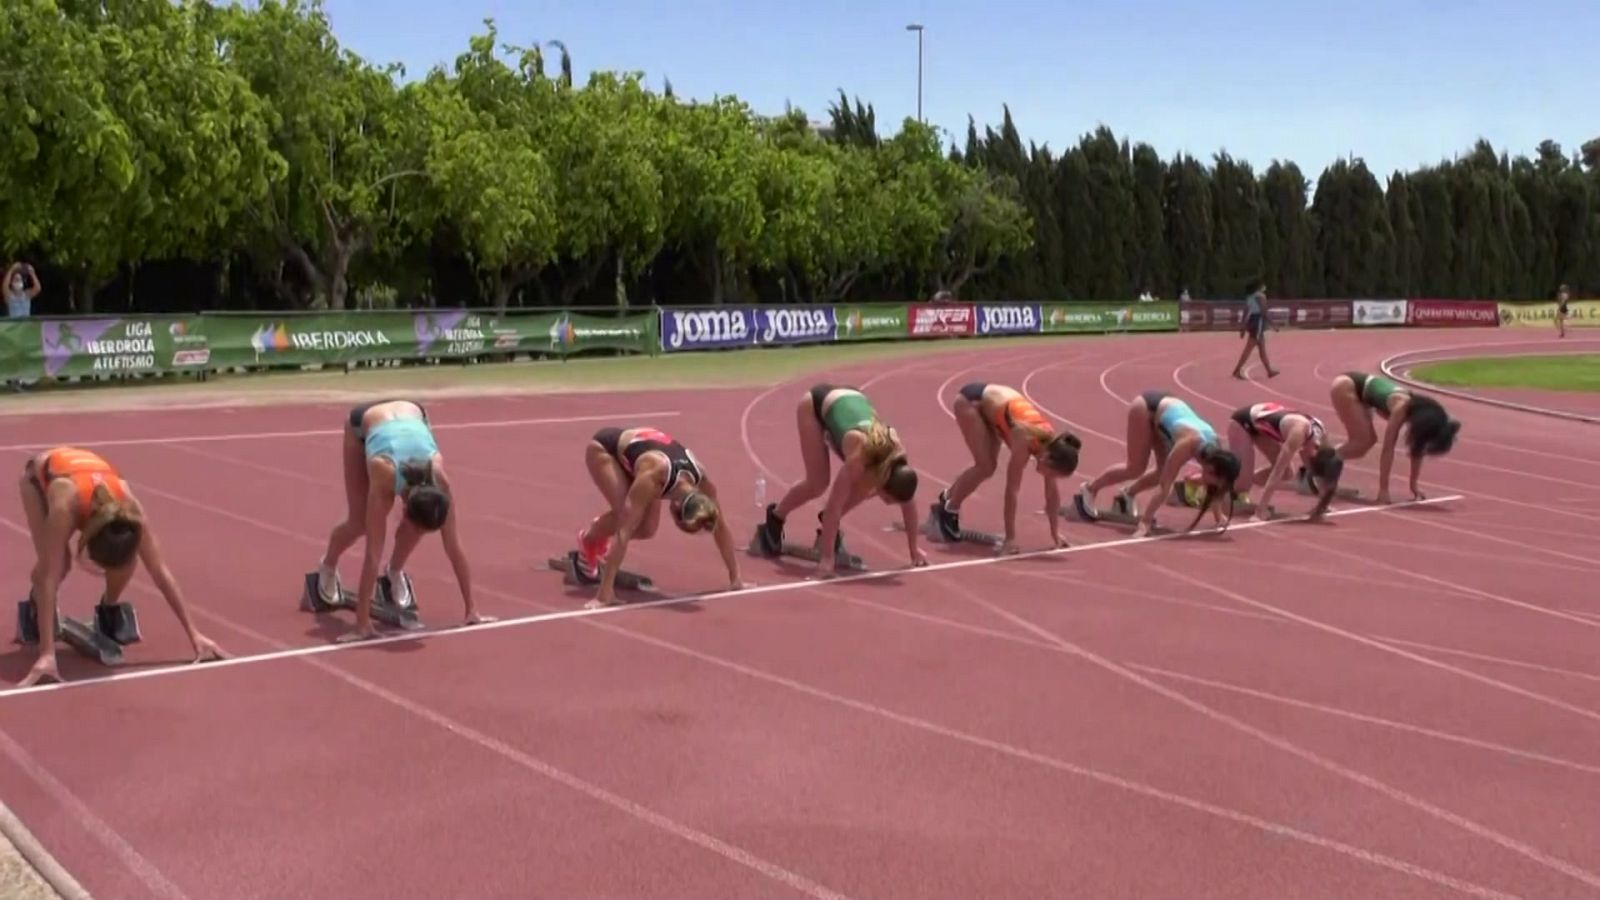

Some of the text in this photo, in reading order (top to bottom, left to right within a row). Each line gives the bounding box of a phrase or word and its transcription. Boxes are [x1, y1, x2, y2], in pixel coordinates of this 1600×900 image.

[125, 321, 152, 337] LIGA
[87, 338, 155, 354] IBERDROLA
[291, 328, 391, 350] IBERDROLA
[93, 354, 154, 370] ATLETISMO
